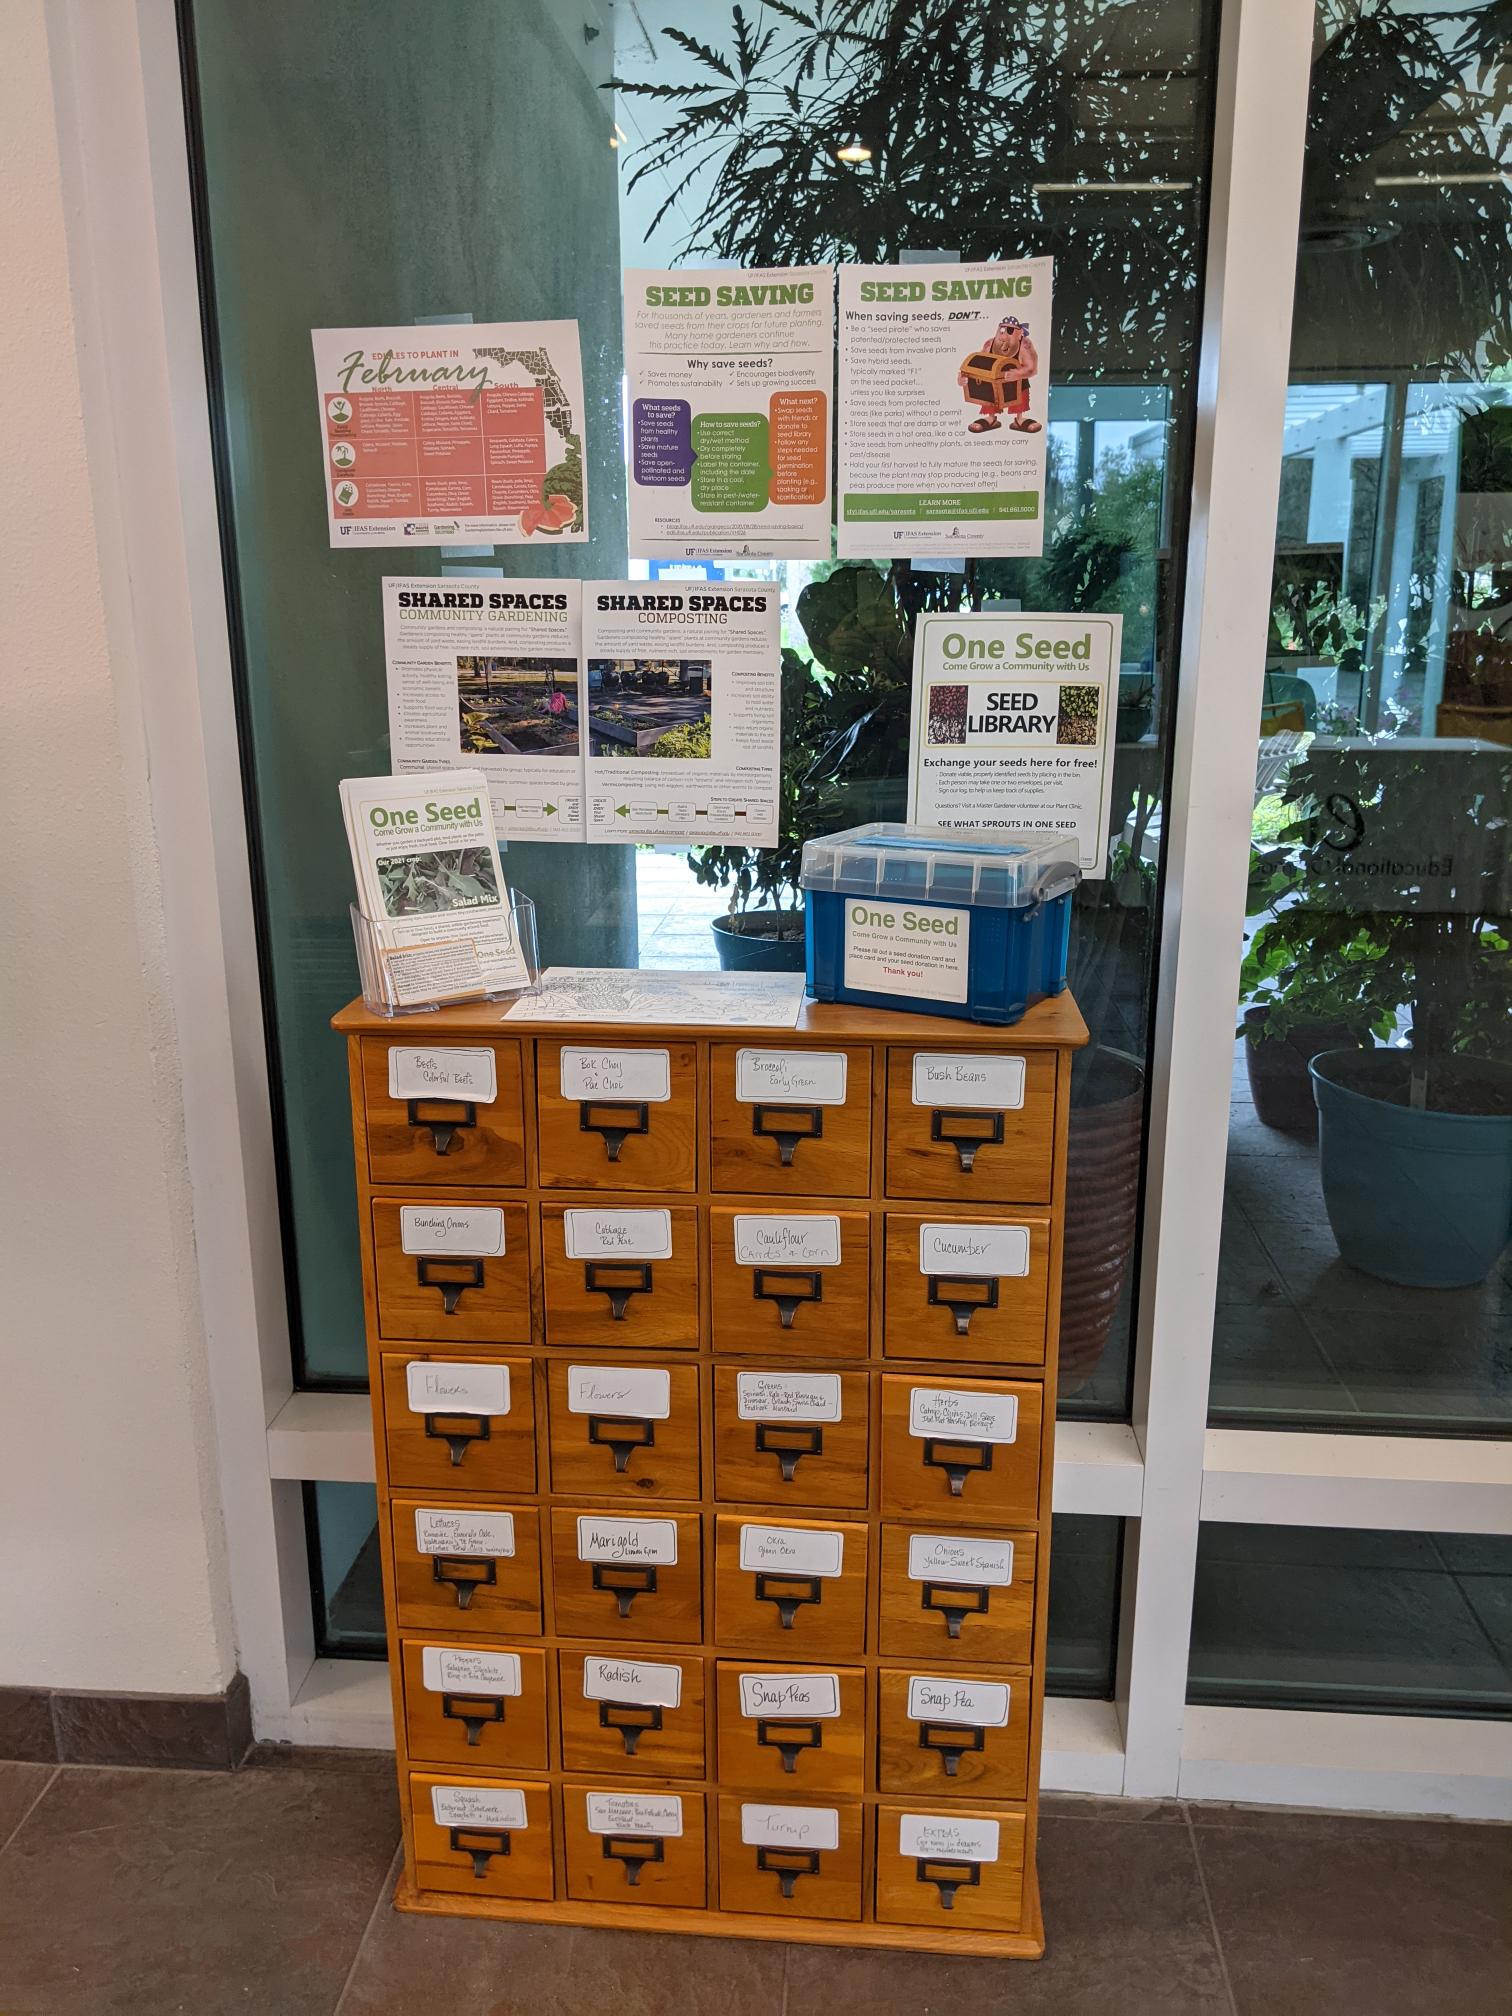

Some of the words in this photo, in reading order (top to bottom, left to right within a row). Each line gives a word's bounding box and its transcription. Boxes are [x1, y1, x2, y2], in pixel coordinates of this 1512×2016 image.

[646, 286, 711, 307] SEED
[717, 283, 814, 306] SAVING
[861, 282, 925, 302] SEED
[932, 276, 1032, 301] SAVING
[845, 311, 873, 321] When
[875, 312, 909, 323] saving
[912, 312, 945, 322] seeds,
[851, 336, 920, 344] patented/protected
[420, 351, 447, 359] PLANT
[687, 359, 708, 370] Why
[739, 359, 773, 368] seeds?
[337, 349, 493, 404] February
[737, 371, 776, 379] Encourages
[777, 370, 814, 378] biodiversity
[648, 379, 679, 387] Promotes
[681, 379, 723, 388] sustainability
[737, 379, 750, 387] Sets
[762, 379, 789, 388] growing
[340, 526, 351, 535] UF
[368, 524, 396, 532] Extension
[398, 592, 483, 608] SHARED
[489, 593, 567, 609] SPACES
[597, 595, 683, 611] SHARED
[689, 596, 767, 612] SPACES
[400, 609, 483, 621] COMMUNITY
[488, 611, 567, 622] GARDENING
[638, 613, 728, 624] COMPOSTING
[943, 633, 1005, 659] One
[1015, 633, 1091, 659] Seed
[943, 662, 967, 670] Come
[970, 662, 993, 670] Grow
[1003, 662, 1055, 672] Community
[1057, 662, 1076, 670] with
[1078, 663, 1089, 671] Us
[987, 693, 1038, 711] SEED
[968, 715, 1056, 733] LIBRARY
[924, 758, 970, 768] Exchange
[973, 760, 997, 768] your
[999, 759, 1027, 767] seeds
[1031, 759, 1053, 767] here
[1056, 759, 1071, 767] for
[1074, 759, 1097, 768] free!
[370, 807, 418, 828] One
[425, 798, 482, 823] Seed
[374, 828, 394, 837] Come
[395, 826, 413, 835] Grow
[420, 822, 458, 833] Community
[458, 821, 472, 829] with
[982, 820, 1021, 828] SPROUTS
[377, 858, 390, 866] Our
[452, 898, 478, 907] Salad
[480, 895, 498, 903] Mix
[852, 906, 896, 928] One
[902, 911, 959, 936] Seed
[872, 933, 888, 941] Grow
[895, 935, 932, 947] Community
[933, 939, 947, 947] with
[853, 946, 870, 954] Please
[908, 952, 930, 960] donation
[883, 967, 905, 976] Thank
[907, 970, 923, 978] you!
[579, 1058, 597, 1069] Bok
[601, 1058, 623, 1077] Choy
[752, 1057, 790, 1073] Broccoli
[423, 1071, 450, 1083] Colorful
[452, 1073, 474, 1085] Beets
[926, 1066, 952, 1081] Bush
[955, 1066, 987, 1082] Beans
[583, 1079, 599, 1090] Pac
[602, 1078, 624, 1089] Choi
[769, 1074, 791, 1093] Early
[792, 1075, 816, 1086] Green
[414, 1217, 446, 1238] Bunching
[802, 1247, 830, 1258] Corn
[933, 1237, 991, 1256] Cucumber
[425, 1375, 468, 1395] Flowers
[579, 1382, 631, 1400] Flowers
[758, 1381, 782, 1392] Greens
[932, 1393, 959, 1407] Herbs
[590, 1531, 639, 1558] Marigold
[766, 1537, 786, 1545] Okra
[935, 1544, 965, 1556] Onions
[975, 1557, 1005, 1571] Spanish
[599, 1664, 642, 1683] Radish
[752, 1682, 787, 1709] Snap
[786, 1685, 810, 1703] Peas
[920, 1687, 951, 1711] Snap
[954, 1690, 975, 1708] Pea
[754, 1814, 810, 1841] Turnip
